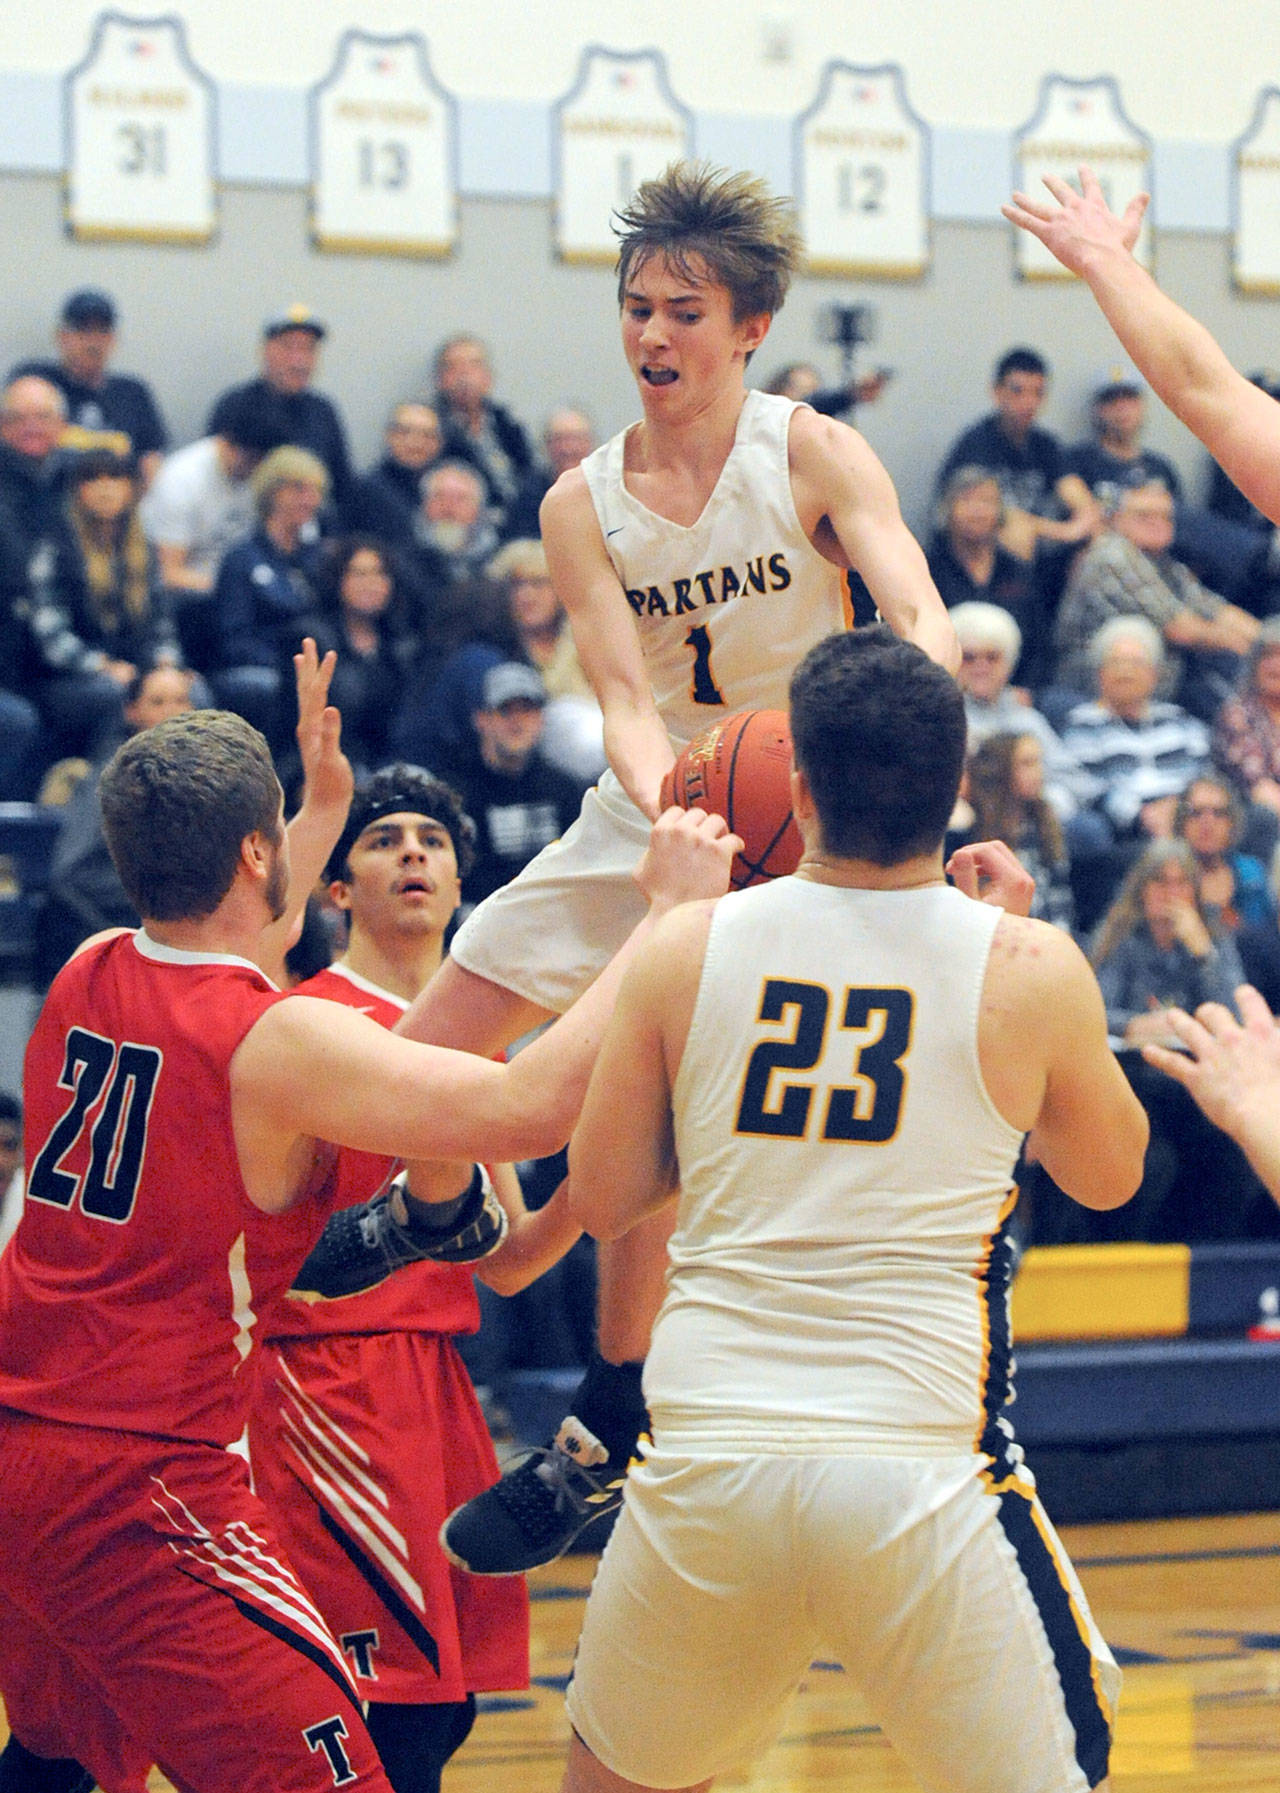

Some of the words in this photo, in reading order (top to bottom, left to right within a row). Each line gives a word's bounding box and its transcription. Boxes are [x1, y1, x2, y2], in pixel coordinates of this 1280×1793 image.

[116, 121, 167, 176] 31
[359, 138, 409, 190] 13
[837, 162, 886, 215] 12
[625, 552, 792, 617] PARTANS
[683, 622, 728, 705] 1
[731, 975, 917, 1146] 23
[26, 1025, 163, 1224] 20
[340, 1628, 380, 1681] T
[301, 1714, 358, 1787] T
